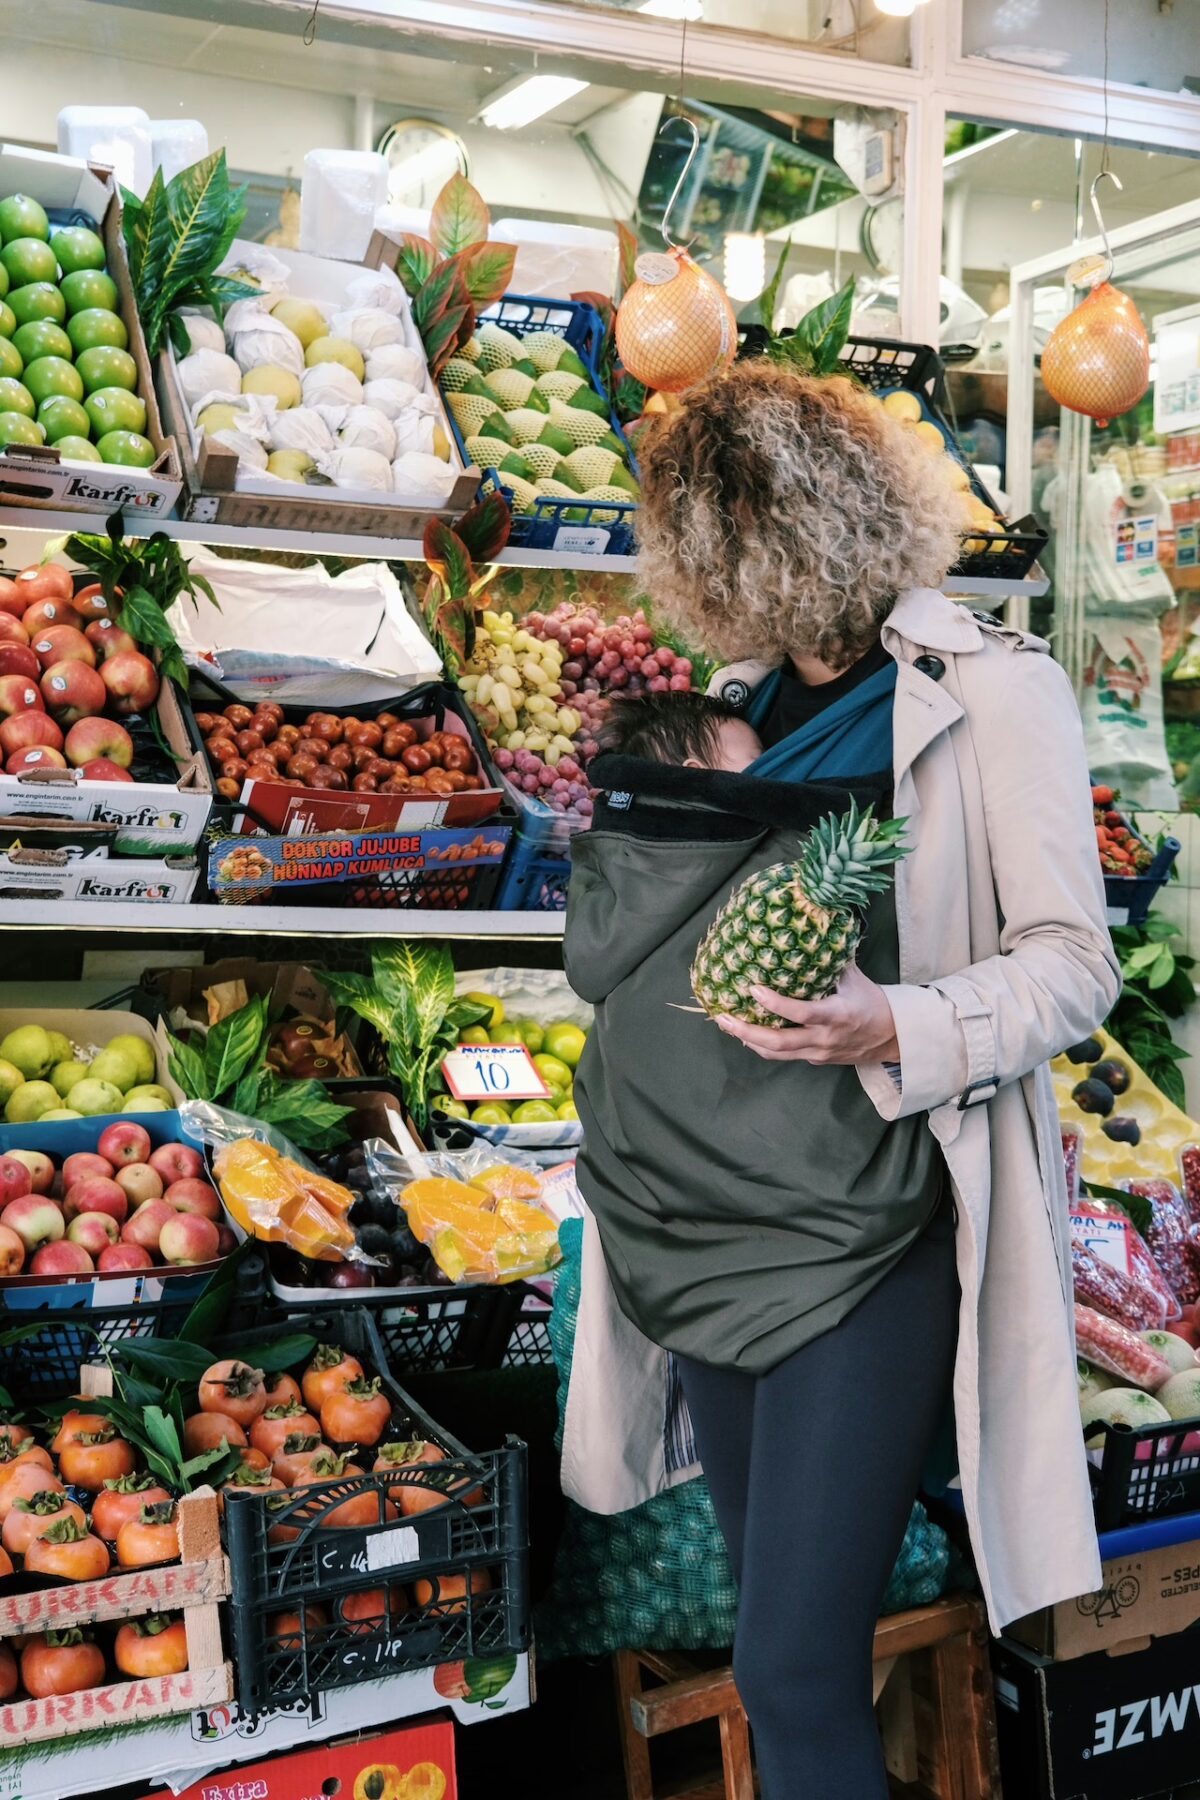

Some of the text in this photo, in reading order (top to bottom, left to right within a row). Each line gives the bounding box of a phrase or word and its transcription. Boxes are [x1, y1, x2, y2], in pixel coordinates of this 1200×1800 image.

[282, 836, 421, 861] DOKTOR JUJUBE
[272, 855, 426, 882] HÜNNAP KUMLUCA
[475, 1060, 510, 1092] 10
